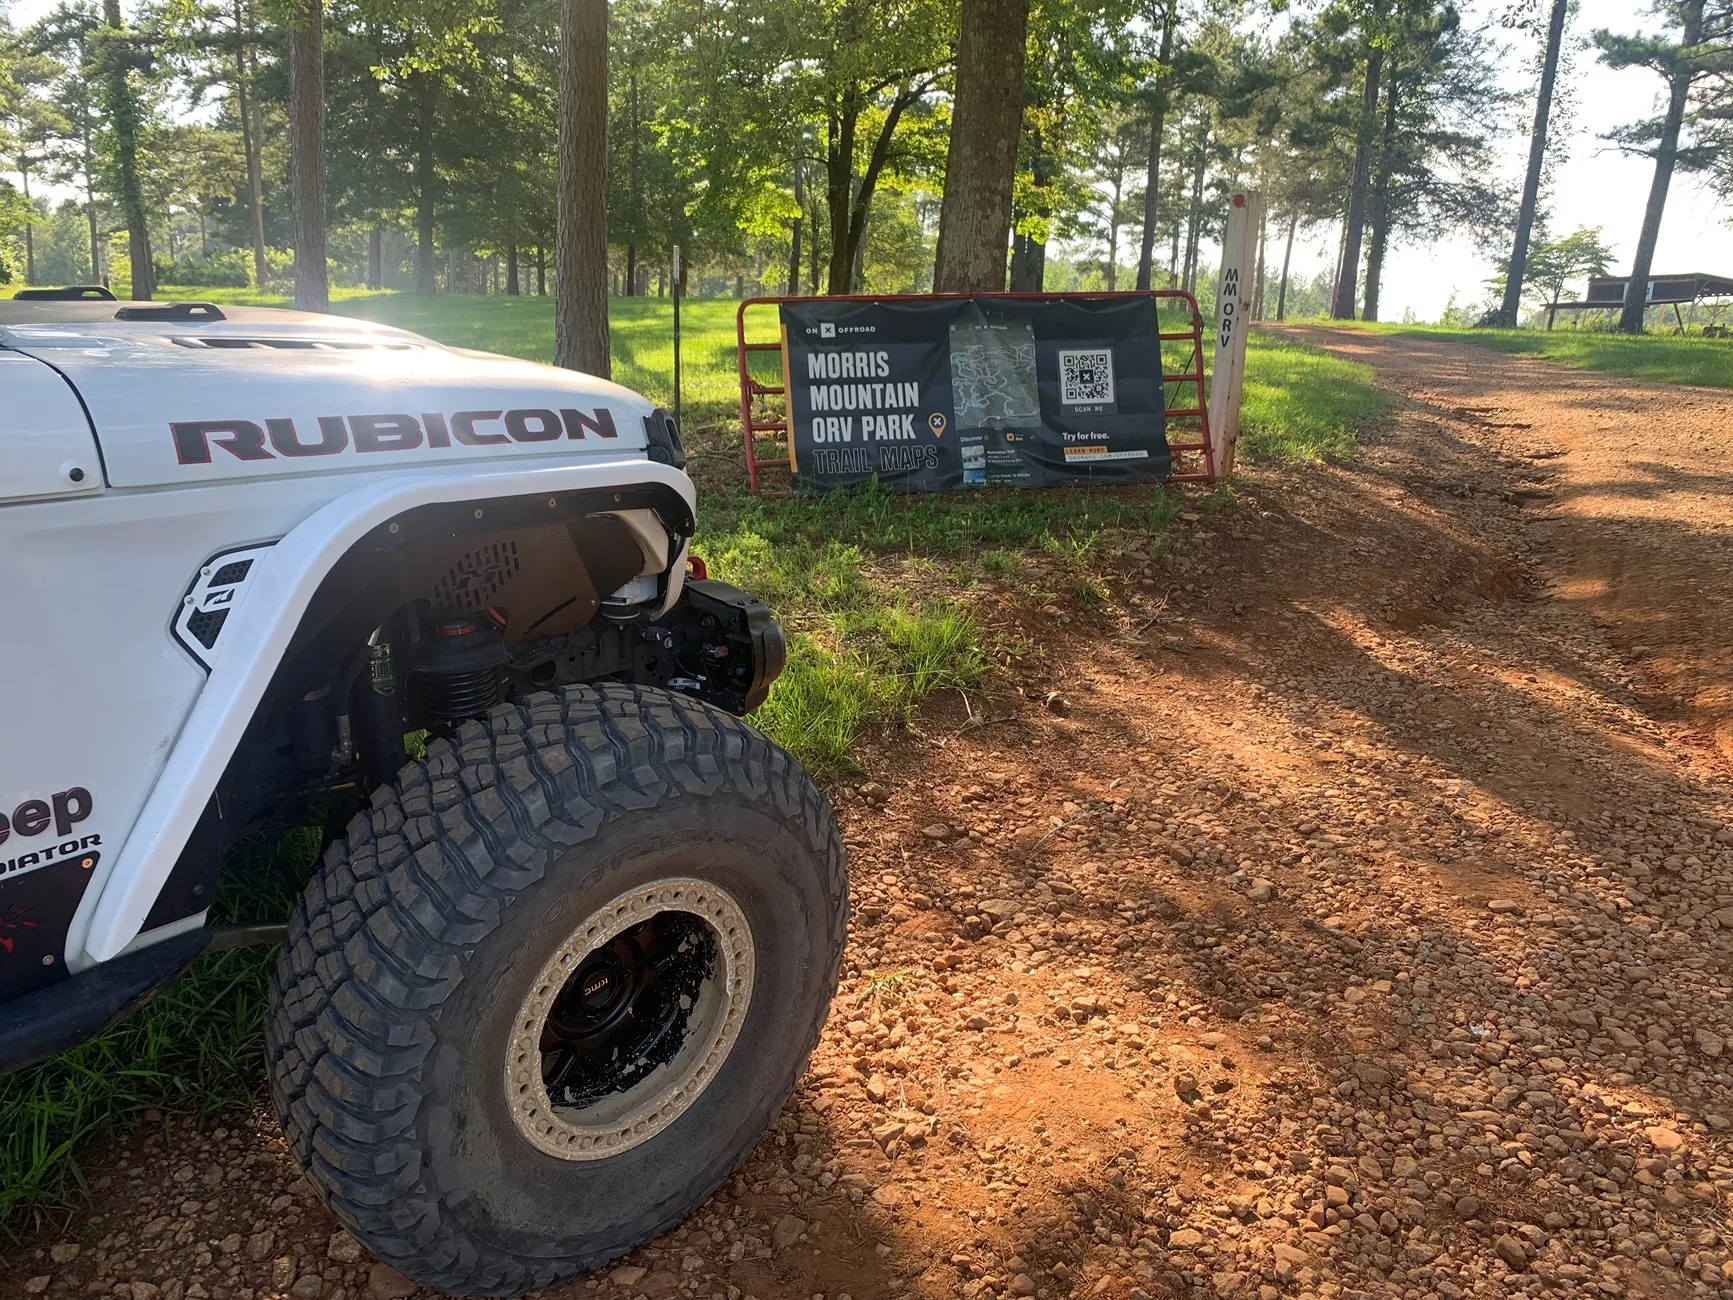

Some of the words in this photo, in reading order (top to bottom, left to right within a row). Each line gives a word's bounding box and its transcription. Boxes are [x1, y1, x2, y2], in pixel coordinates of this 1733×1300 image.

[838, 326, 876, 334] OFFROAD
[807, 351, 890, 379] MORRIS
[810, 382, 920, 411] MOUNTAIN
[1074, 405, 1092, 413] SCAN
[169, 408, 618, 465] RUBICON
[812, 416, 853, 443] ORV
[861, 414, 917, 441] PARK
[1062, 432, 1076, 441] Try
[1077, 432, 1089, 440] for
[1090, 431, 1110, 440] free.
[813, 448, 873, 474] TRAIL
[880, 444, 939, 471] MAPS
[0, 787, 93, 846] ep
